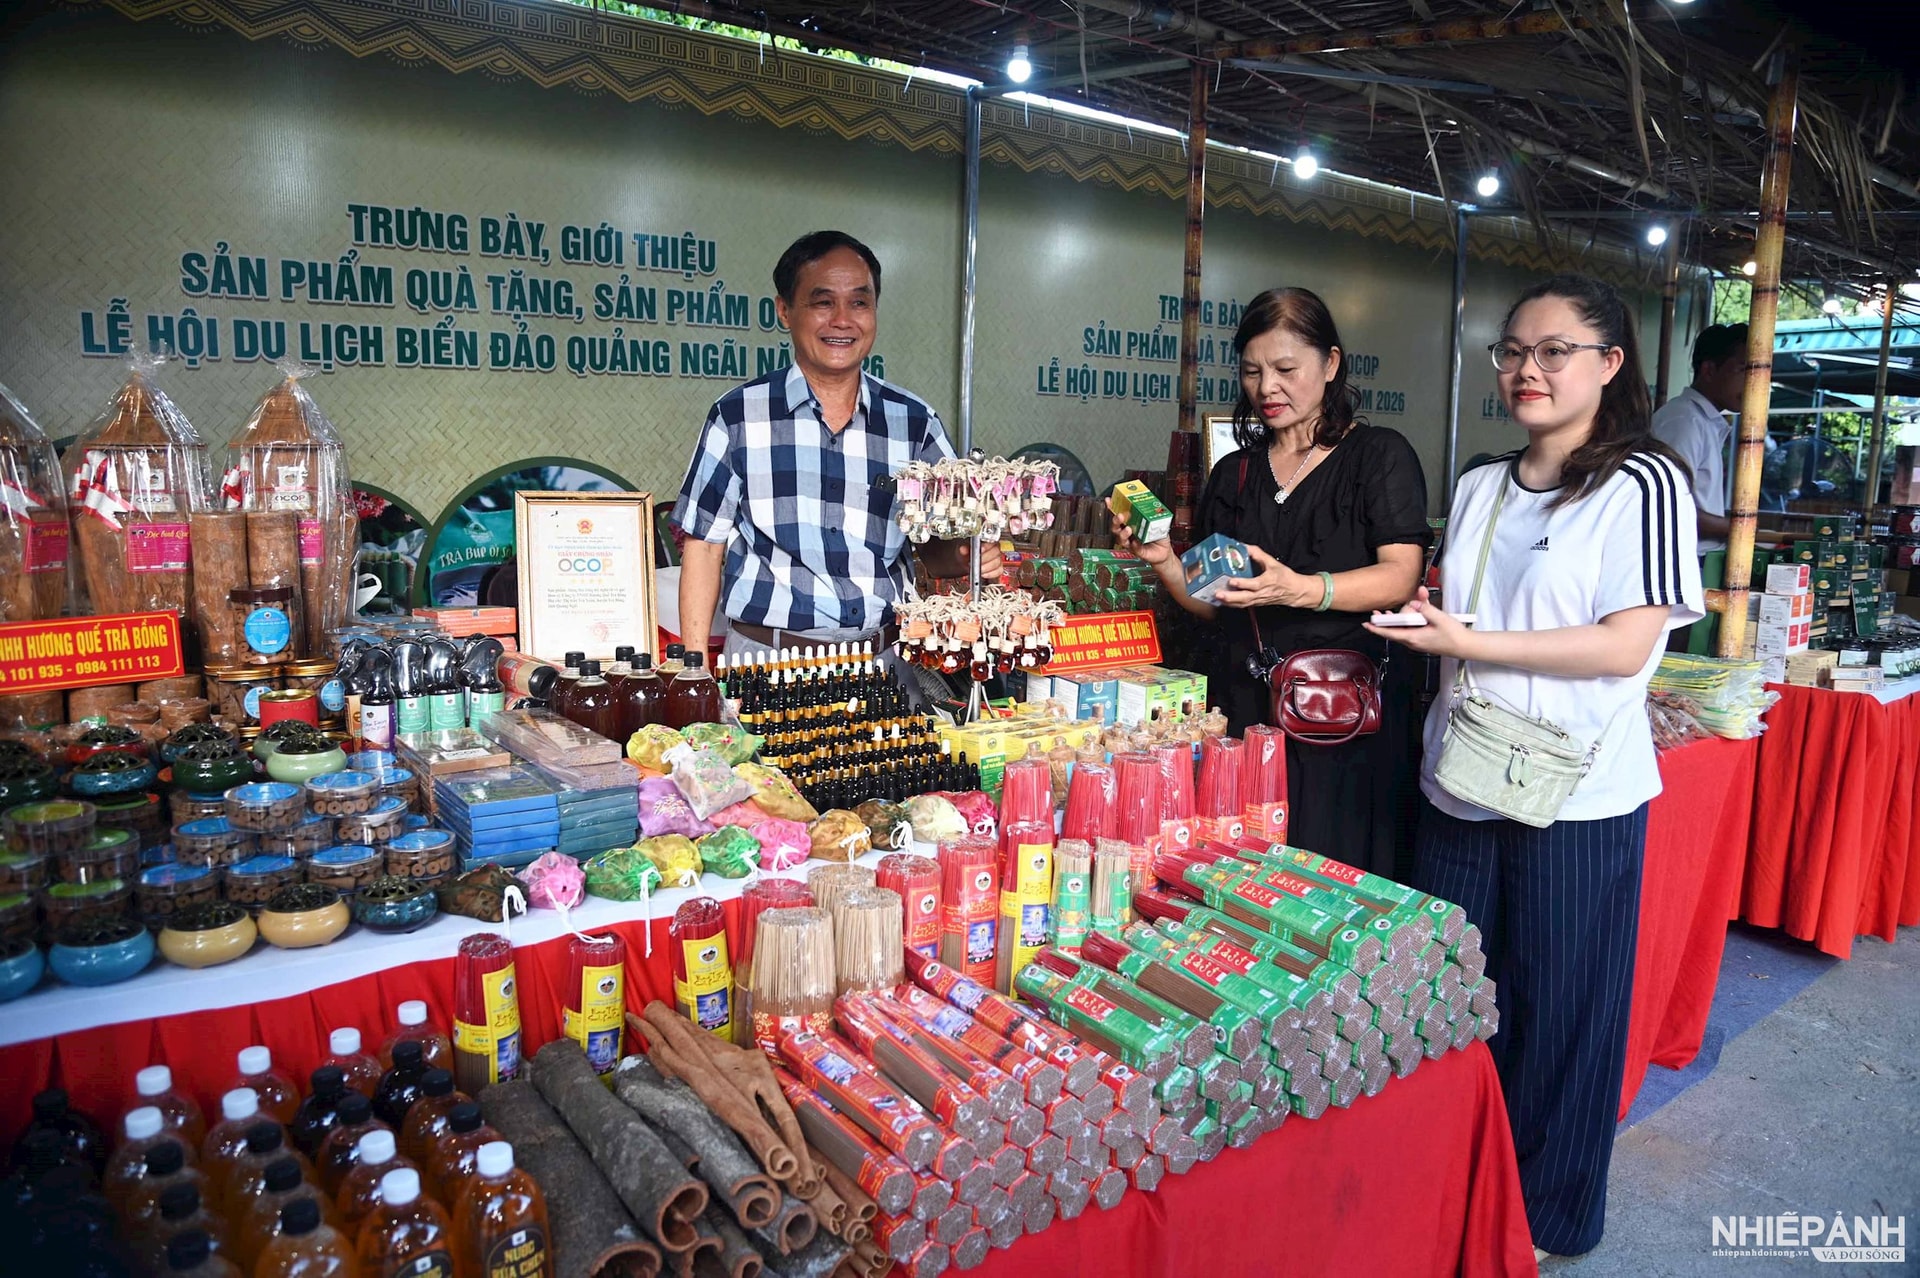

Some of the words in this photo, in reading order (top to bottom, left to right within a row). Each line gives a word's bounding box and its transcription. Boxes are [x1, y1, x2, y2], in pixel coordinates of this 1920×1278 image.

[348, 204, 470, 254] TRƯNG
[481, 212, 550, 264] BÀY,
[560, 222, 624, 268] GIỚI
[634, 232, 718, 282] THIỆU
[181, 242, 268, 300] SẢN
[281, 249, 395, 306] PHẨM
[406, 265, 479, 314] QUÀ
[486, 269, 584, 322] TẶNG,
[594, 274, 657, 323] SẢN
[667, 280, 750, 331] PHẨM
[81, 298, 132, 357] LỄ
[148, 308, 220, 370] HỘI
[232, 319, 287, 364] DU
[300, 323, 386, 371] LỊCH
[395, 315, 480, 369] BIỂN
[489, 322, 556, 371] ĐẢO
[567, 327, 671, 378] QUẢNG
[680, 339, 748, 378] NGÃI
[1083, 320, 1121, 356] SẢN
[1127, 324, 1177, 360] PHẨM
[1037, 357, 1060, 392] LỄ
[1066, 363, 1097, 400] HỘI
[1103, 370, 1127, 397] DU
[1133, 372, 1171, 404] LỊCH
[1346, 354, 1379, 376] OCOP
[1376, 390, 1405, 412] 2026
[558, 558, 613, 573] OCOP
[0, 636, 24, 662] NHH
[26, 631, 74, 659] HƯƠNG
[76, 622, 103, 657] QUẾ
[104, 624, 131, 652] TRÀ
[1102, 618, 1118, 644] QUẾ
[1117, 619, 1132, 641] TRÀ
[10, 667, 34, 681] 101
[38, 664, 63, 679] 935
[75, 660, 107, 675] 0984
[111, 657, 133, 671] 111
[137, 655, 160, 669] 113
